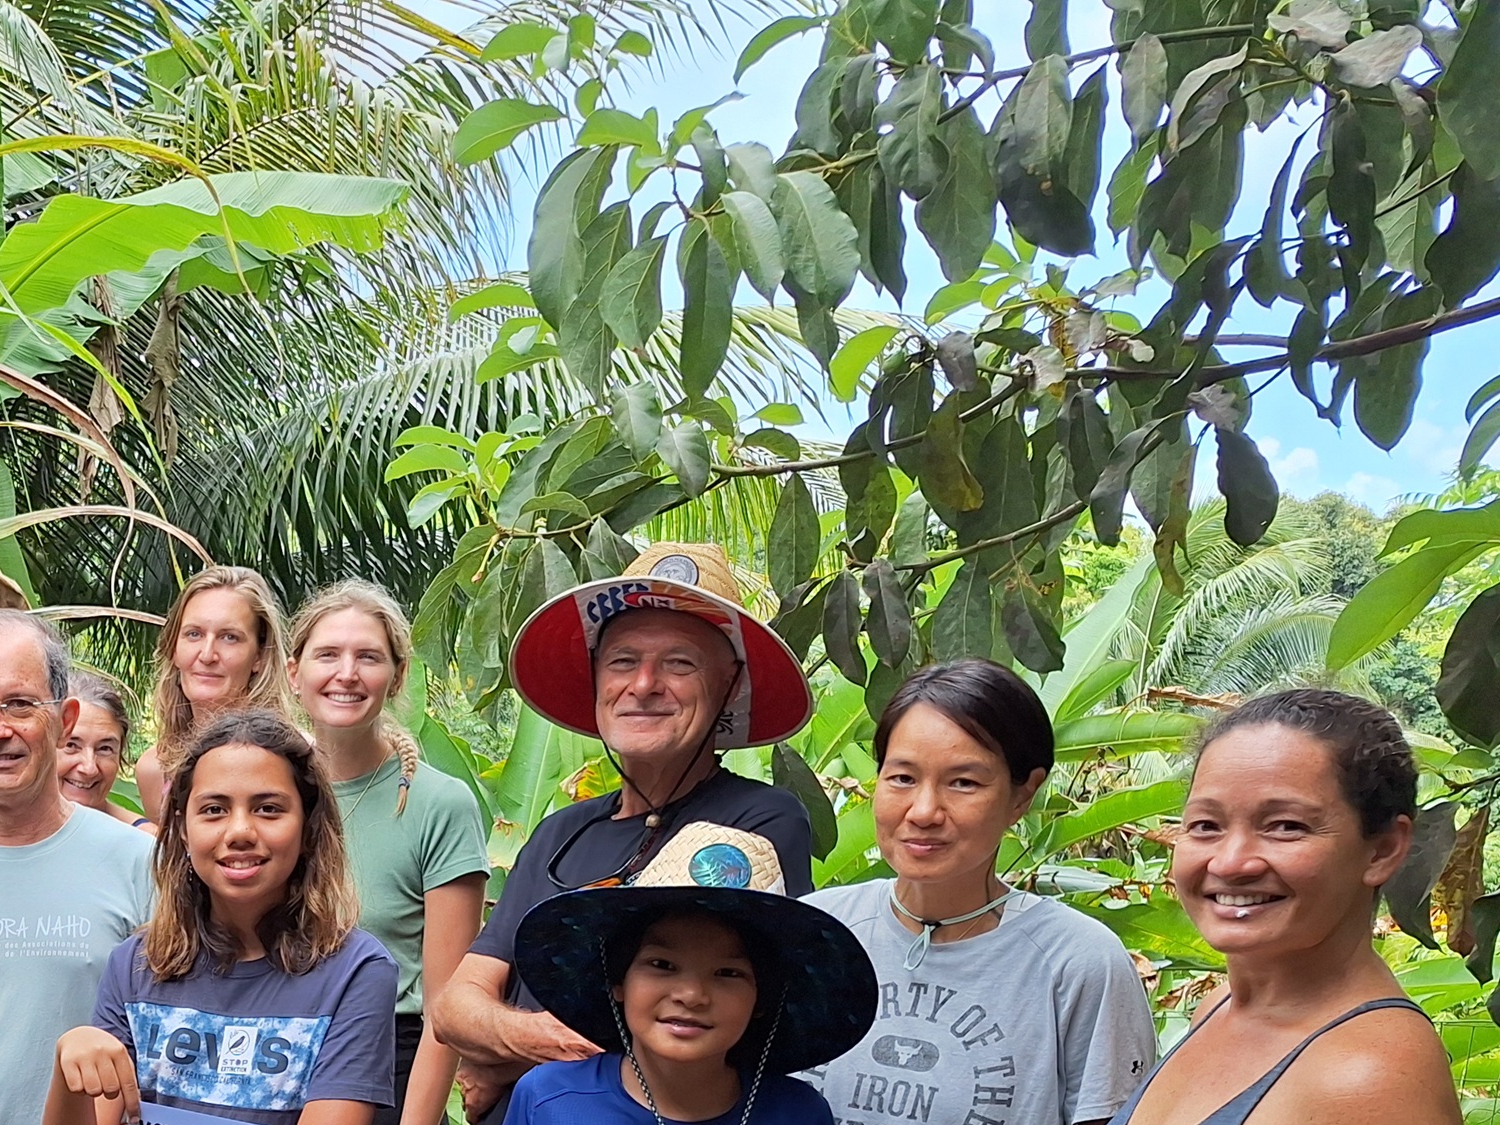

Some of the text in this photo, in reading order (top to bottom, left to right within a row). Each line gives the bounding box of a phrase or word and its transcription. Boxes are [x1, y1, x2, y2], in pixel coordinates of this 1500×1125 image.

[35, 914, 91, 938] NAHO
[950, 1003, 1006, 1051] OF
[847, 1072, 940, 1123] IRON
